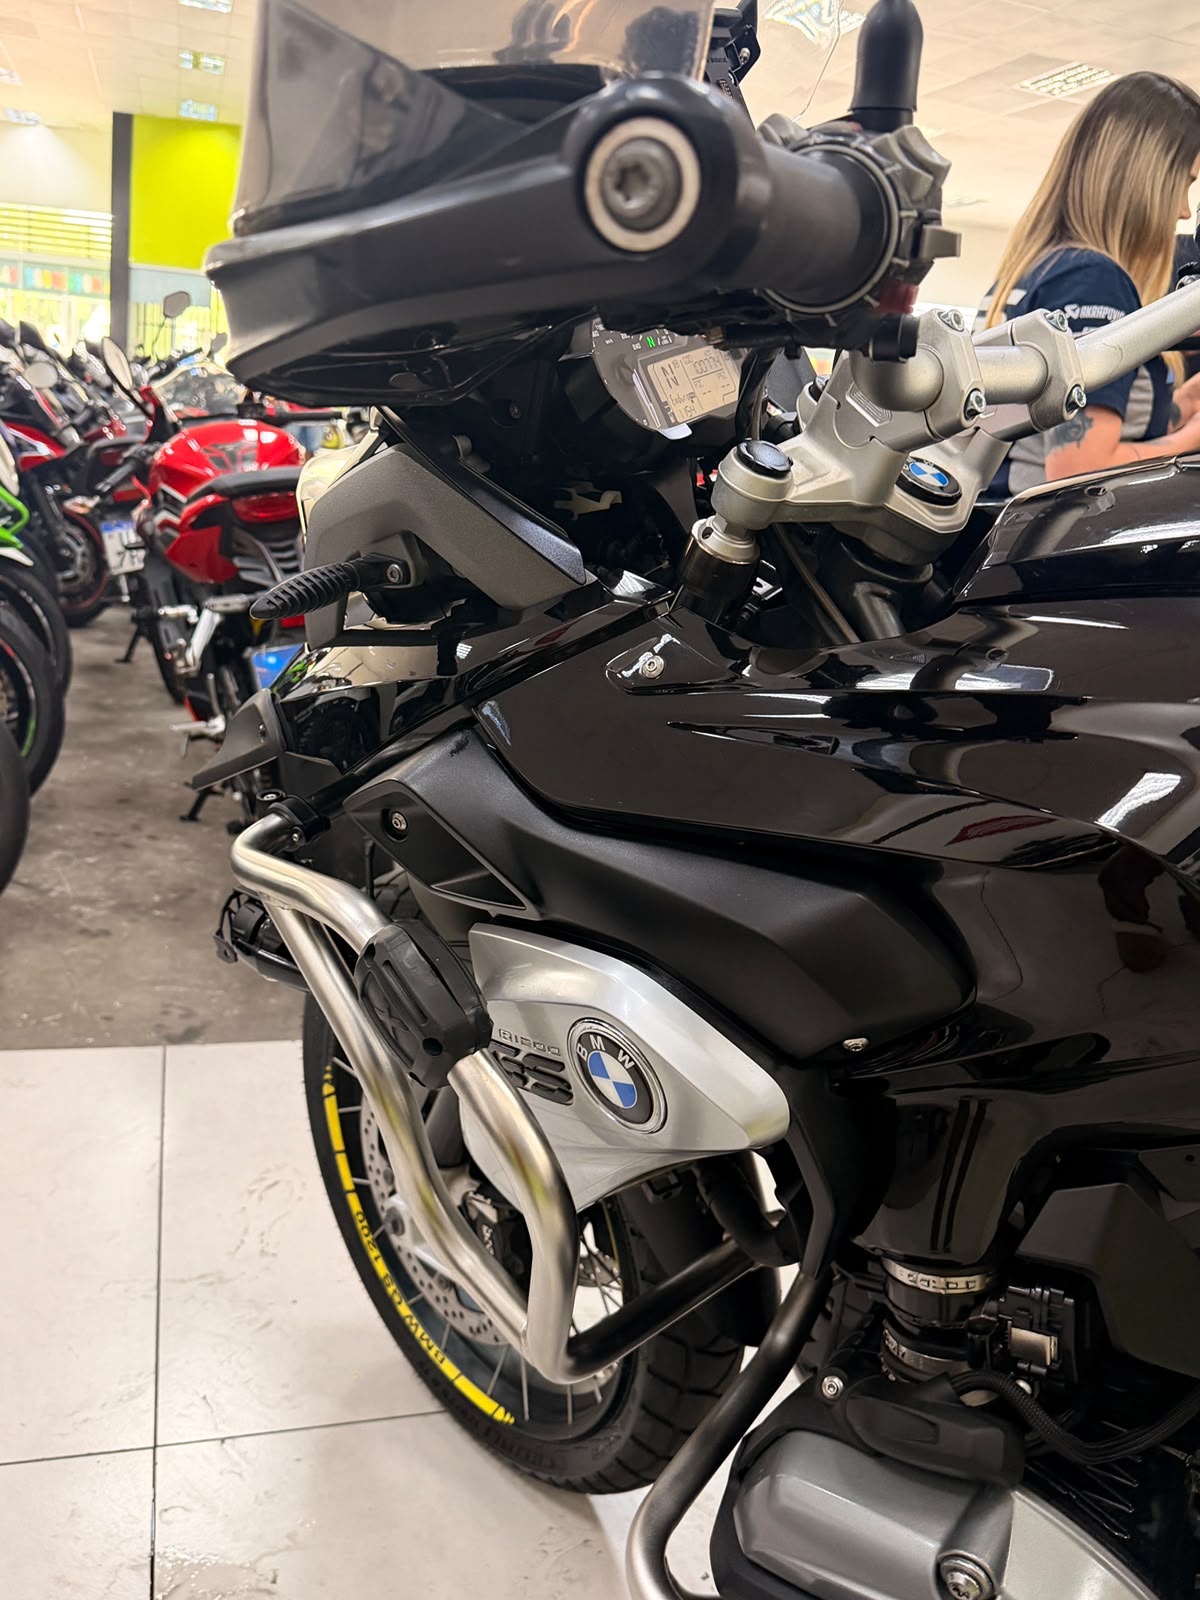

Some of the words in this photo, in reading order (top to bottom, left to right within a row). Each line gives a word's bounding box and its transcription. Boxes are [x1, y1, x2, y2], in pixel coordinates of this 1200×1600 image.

[660, 363, 680, 390] N
[498, 1028, 562, 1057] R1200
[575, 1034, 636, 1070] BMW
[355, 1211, 381, 1261] 1200
[381, 1273, 404, 1305] GS
[404, 1314, 446, 1364] BMW
